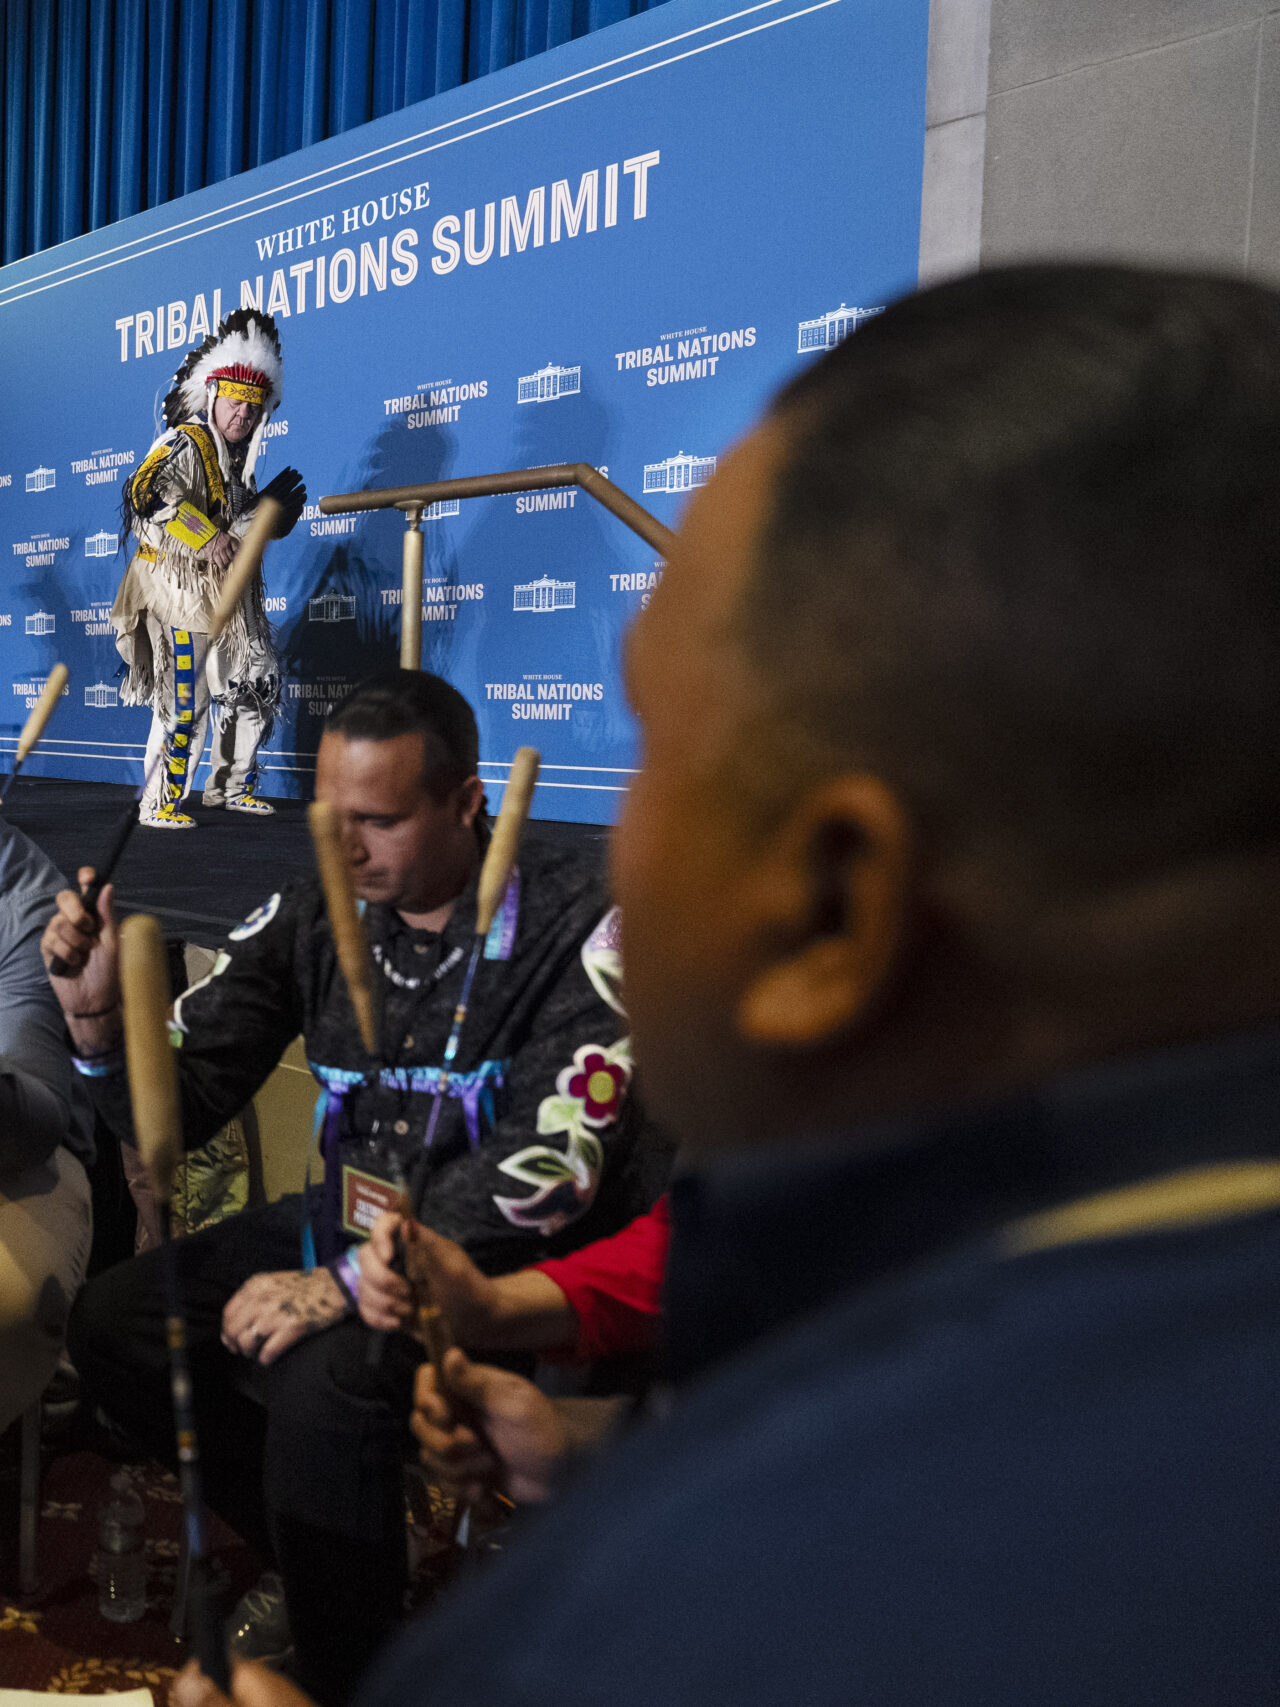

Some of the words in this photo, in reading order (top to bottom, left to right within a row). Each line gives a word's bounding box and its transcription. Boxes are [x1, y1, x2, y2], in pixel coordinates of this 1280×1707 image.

[255, 214, 336, 262] WHITE
[342, 182, 431, 234] HOUSE
[115, 288, 222, 363] TRIBAL
[240, 227, 419, 319] NATIONS
[431, 150, 661, 276] SUMMIT
[660, 330, 682, 341] WHITE
[683, 326, 708, 337] HOUSE
[615, 343, 673, 371] TRIBAL
[677, 327, 757, 359] NATIONS
[646, 356, 720, 388] SUMMIT
[384, 392, 428, 416] TRIBAL
[429, 380, 488, 408] NATIONS
[407, 404, 461, 431] SUMMIT
[71, 459, 98, 475] TRIBAL
[99, 450, 135, 468] NATIONS
[85, 468, 119, 486] SUMMIT
[516, 490, 578, 514] SUMMIT
[310, 517, 357, 537] SUMMIT
[12, 542, 37, 556] TRIBAL
[38, 537, 70, 553] NATIONS
[25, 552, 55, 568] SUMMIT
[426, 583, 484, 603] NATIONS
[70, 609, 97, 622] TRIBAL
[421, 604, 458, 622] MMIT
[12, 683, 37, 696] TRIBAL
[288, 684, 326, 699] TRIBAL
[485, 683, 535, 701] TRIBAL
[537, 683, 604, 701] NATIONS
[511, 703, 573, 721] SUMMIT
